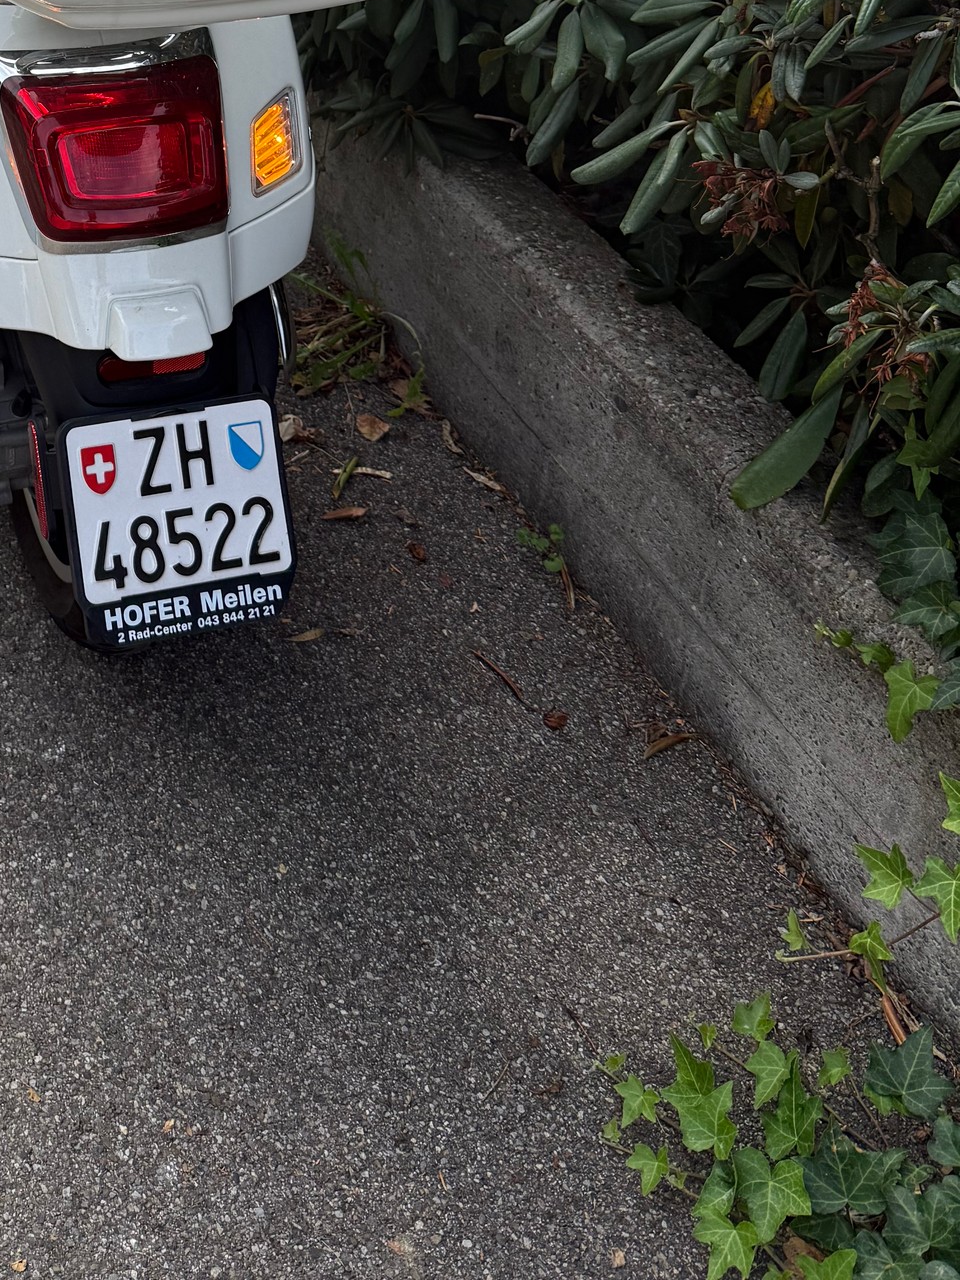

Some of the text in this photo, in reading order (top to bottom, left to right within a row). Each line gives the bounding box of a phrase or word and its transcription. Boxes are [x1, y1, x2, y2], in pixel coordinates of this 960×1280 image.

[133, 420, 215, 497] ZH
[94, 496, 281, 589] 48522
[104, 584, 283, 631] HOFER Meilen
[118, 604, 275, 643] 2 Rad-Center 043 844 21 21
